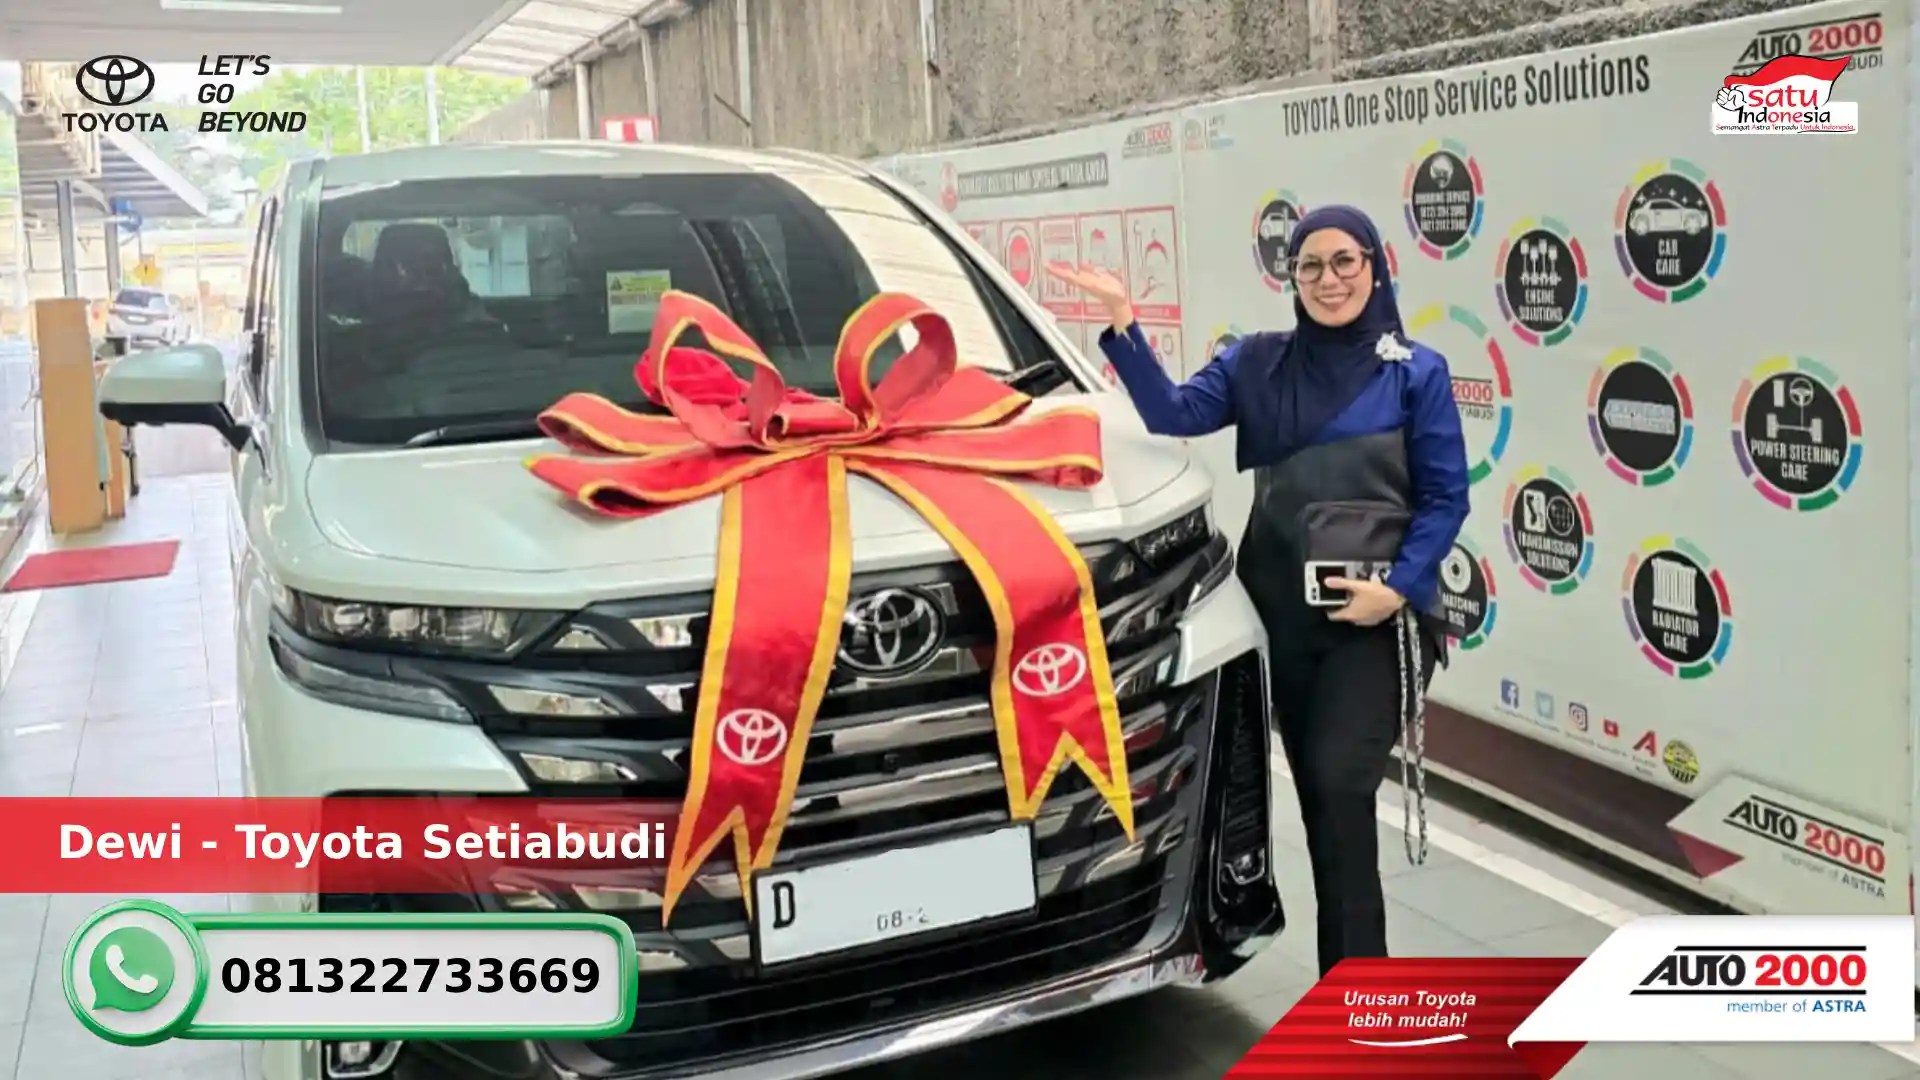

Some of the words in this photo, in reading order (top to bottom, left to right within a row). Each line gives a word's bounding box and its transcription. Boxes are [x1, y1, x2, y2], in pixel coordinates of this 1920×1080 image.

[1738, 32, 1802, 63] AUTO
[1808, 20, 1883, 53] 2000
[1282, 95, 1340, 136] TOYOTA
[1345, 93, 1379, 128] One
[1384, 85, 1428, 124] Stop
[1434, 70, 1517, 117] Service
[1524, 53, 1650, 106] Solutions
[1658, 238, 1678, 256] CAR
[1655, 258, 1680, 276] CARE
[1525, 288, 1554, 305] ENGINE
[1519, 305, 1563, 322] SOLUTIONS
[1451, 382, 1493, 401] 2000
[1750, 437, 1787, 459] POWER
[1789, 444, 1840, 467] STEERING
[1781, 461, 1808, 480] CARE
[1652, 609, 1699, 638] RADIATOR
[1663, 631, 1688, 655] CARE
[1728, 800, 1798, 841] AUTO
[1804, 821, 1885, 874] 2000
[1842, 873, 1885, 898] ASTRA
[771, 880, 796, 929] D
